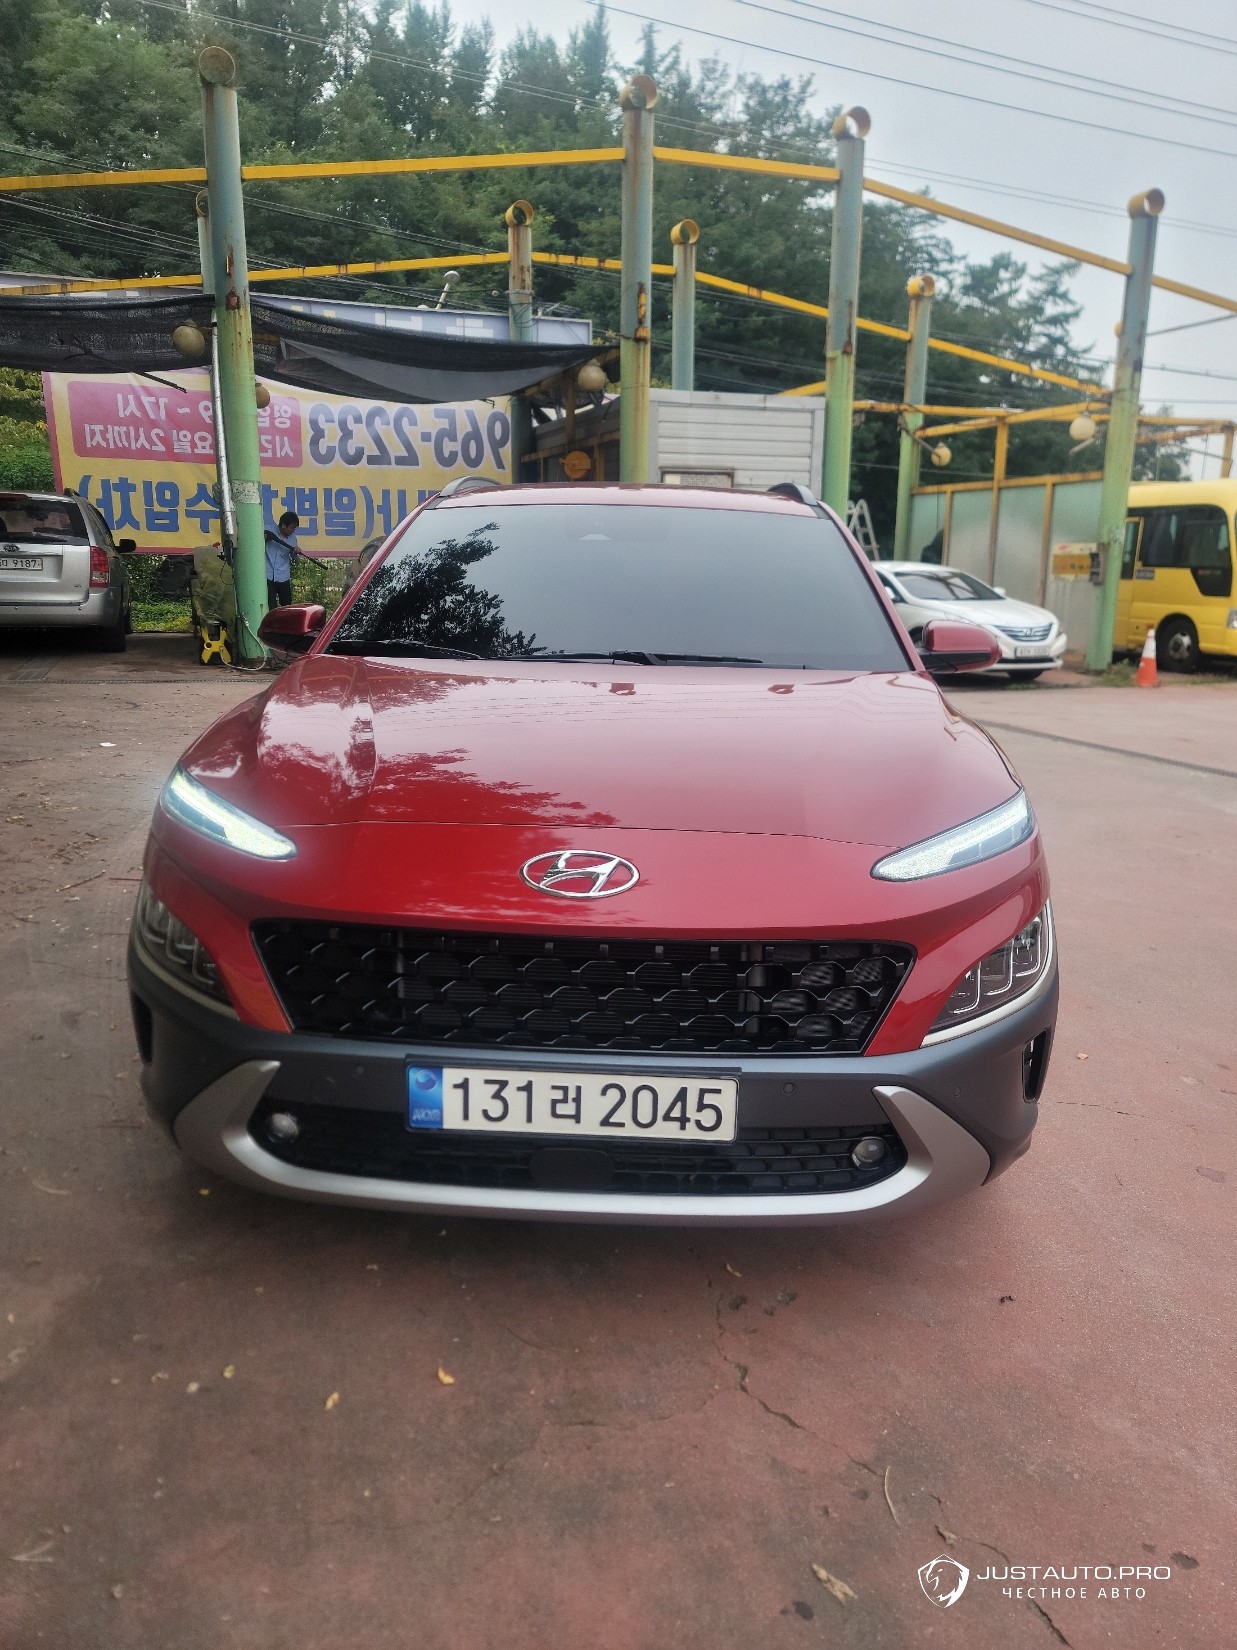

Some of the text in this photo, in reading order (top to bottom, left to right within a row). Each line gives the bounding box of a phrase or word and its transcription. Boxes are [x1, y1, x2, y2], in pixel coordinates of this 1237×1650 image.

[12, 559, 37, 568] 9187
[453, 1077, 723, 1132] 131러 2045
